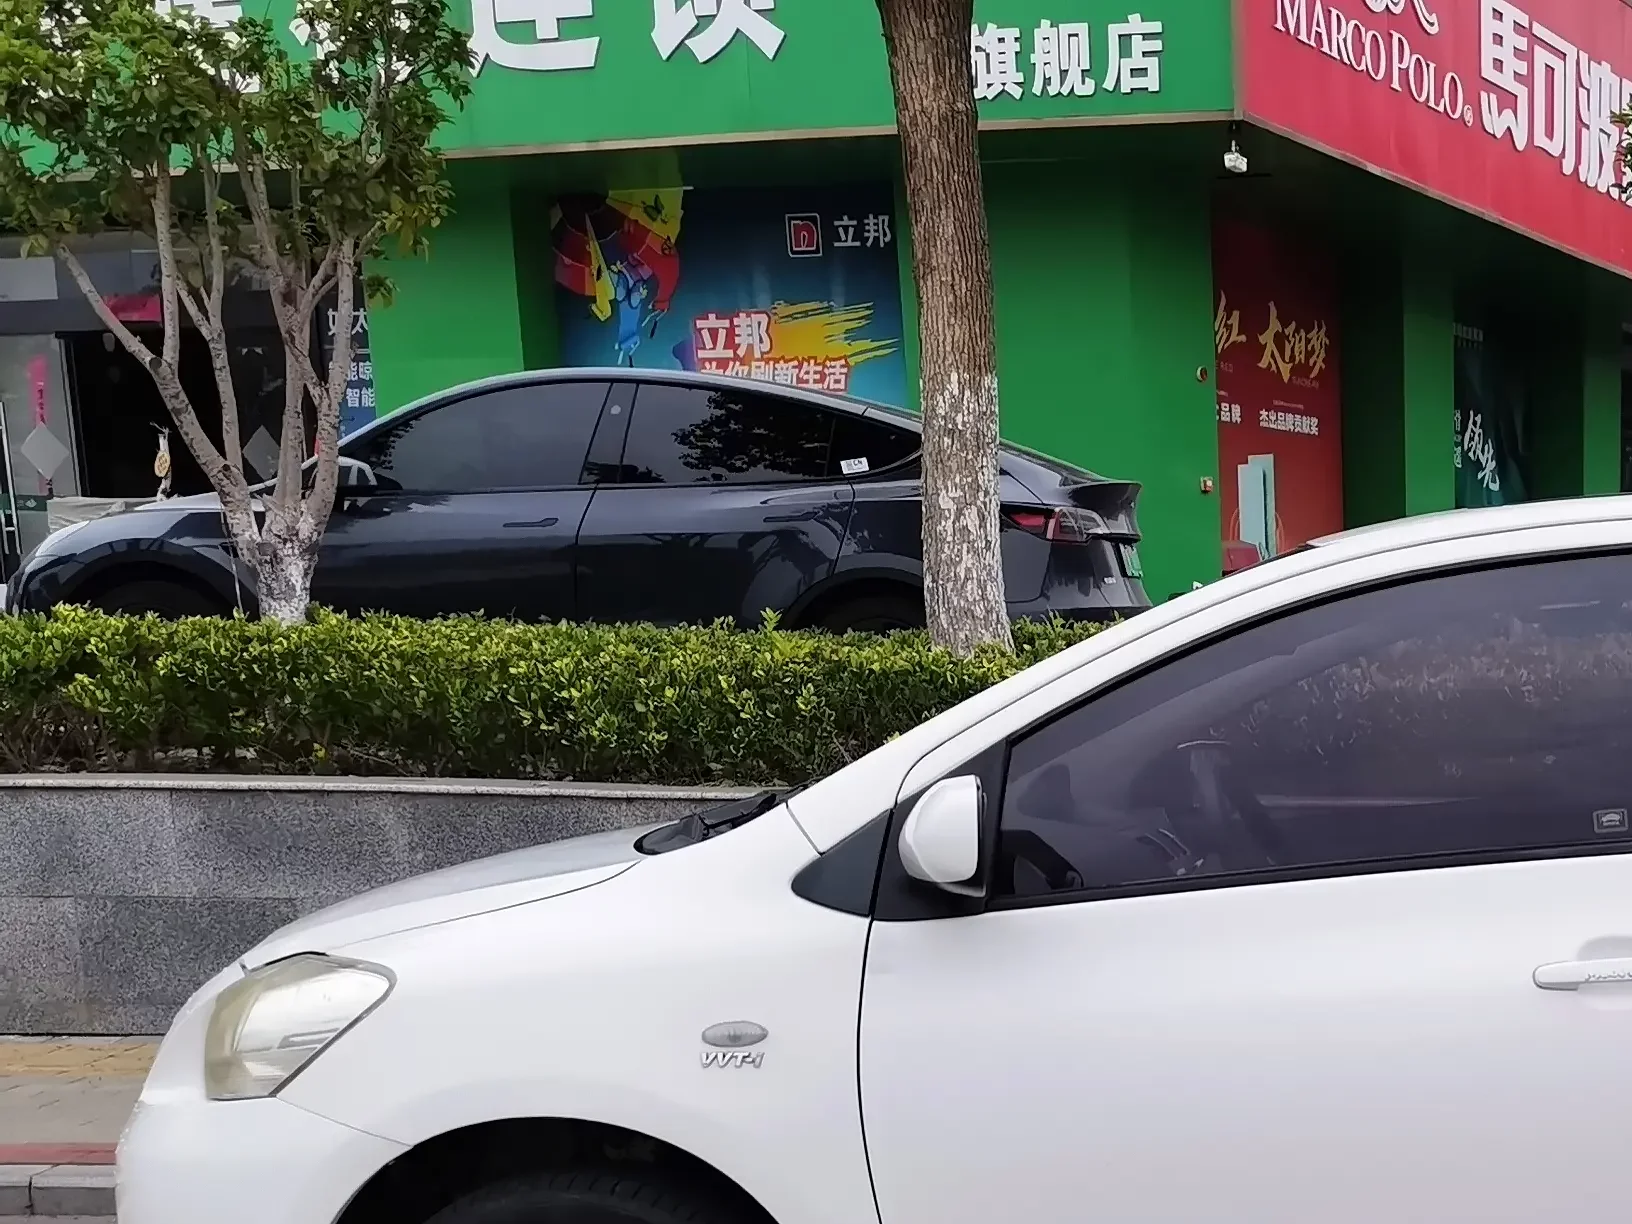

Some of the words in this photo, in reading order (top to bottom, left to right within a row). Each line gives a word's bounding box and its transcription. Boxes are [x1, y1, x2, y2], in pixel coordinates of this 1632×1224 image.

[971, 12, 1163, 100] 旗舰店
[1273, 0, 1386, 81] MARCO
[833, 214, 892, 248] 立邦
[695, 312, 771, 359] 立邦
[1256, 300, 1330, 384] 太阳梦
[1216, 402, 1242, 424] 品牌
